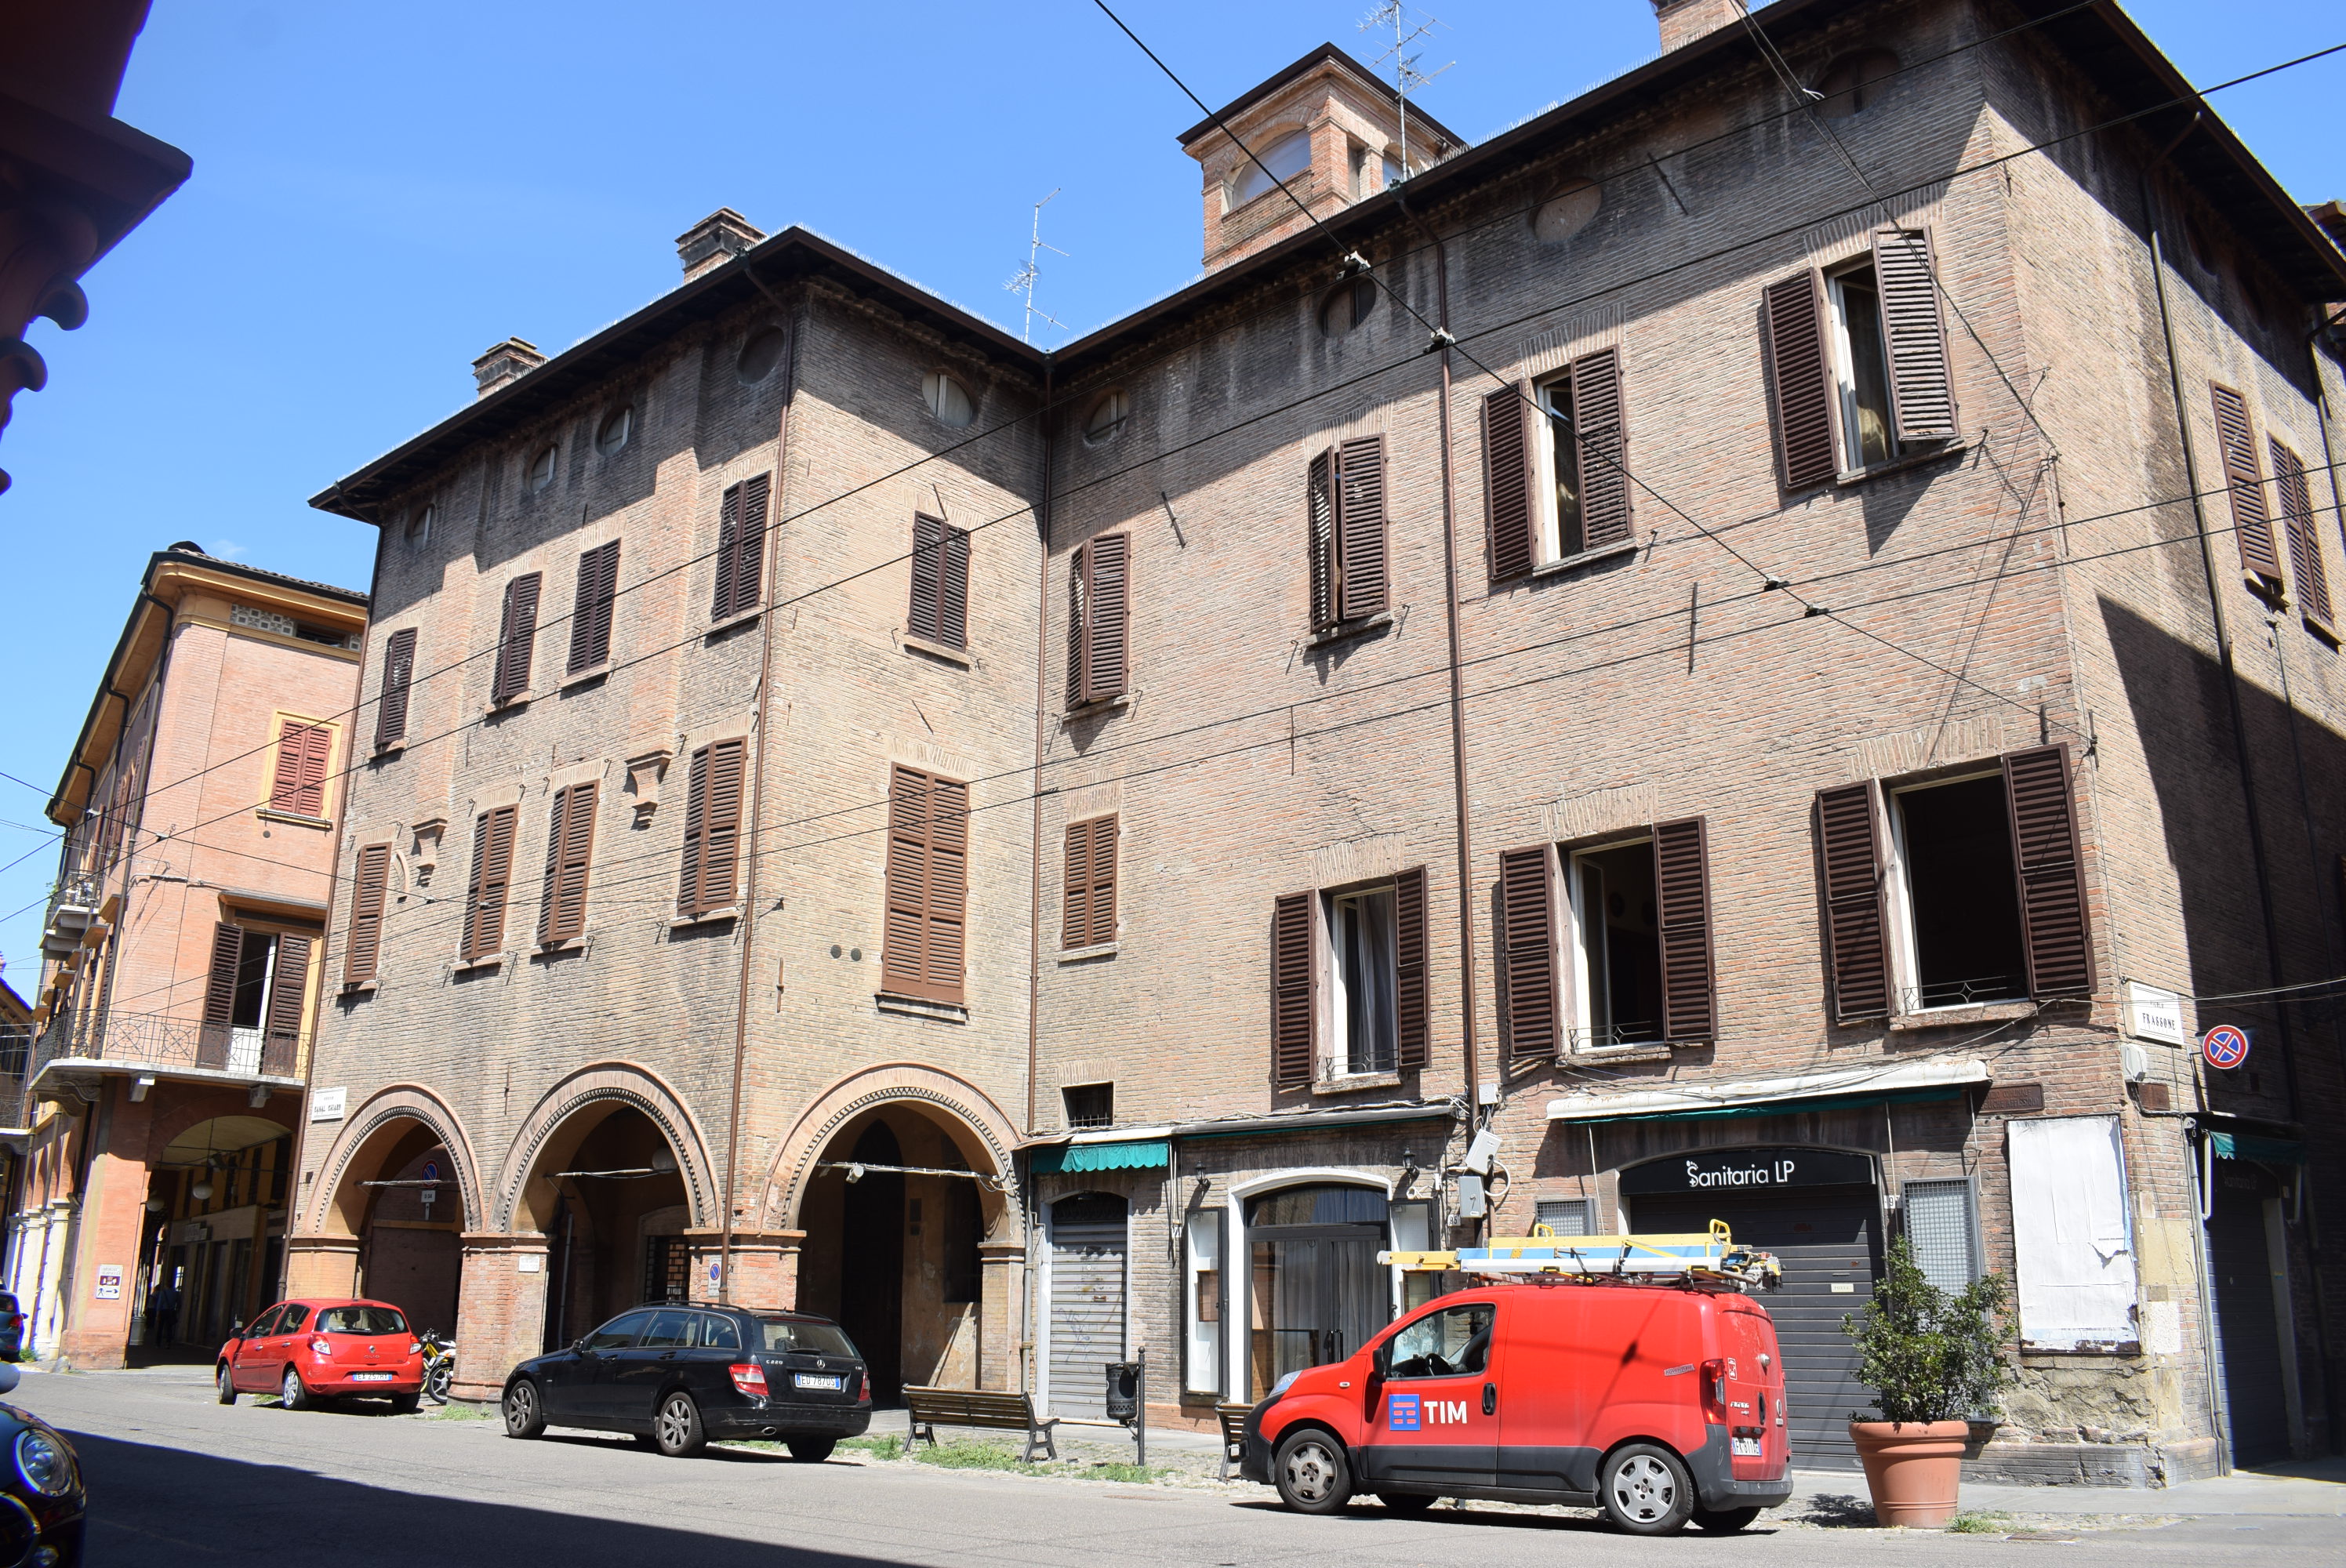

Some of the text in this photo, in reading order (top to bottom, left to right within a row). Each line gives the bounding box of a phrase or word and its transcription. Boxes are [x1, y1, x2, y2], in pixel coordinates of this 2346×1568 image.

[2142, 1012, 2176, 1030] FRASSONE
[1686, 1160, 1795, 1188] Sanitaria LP
[1423, 1401, 1468, 1424] TIM
